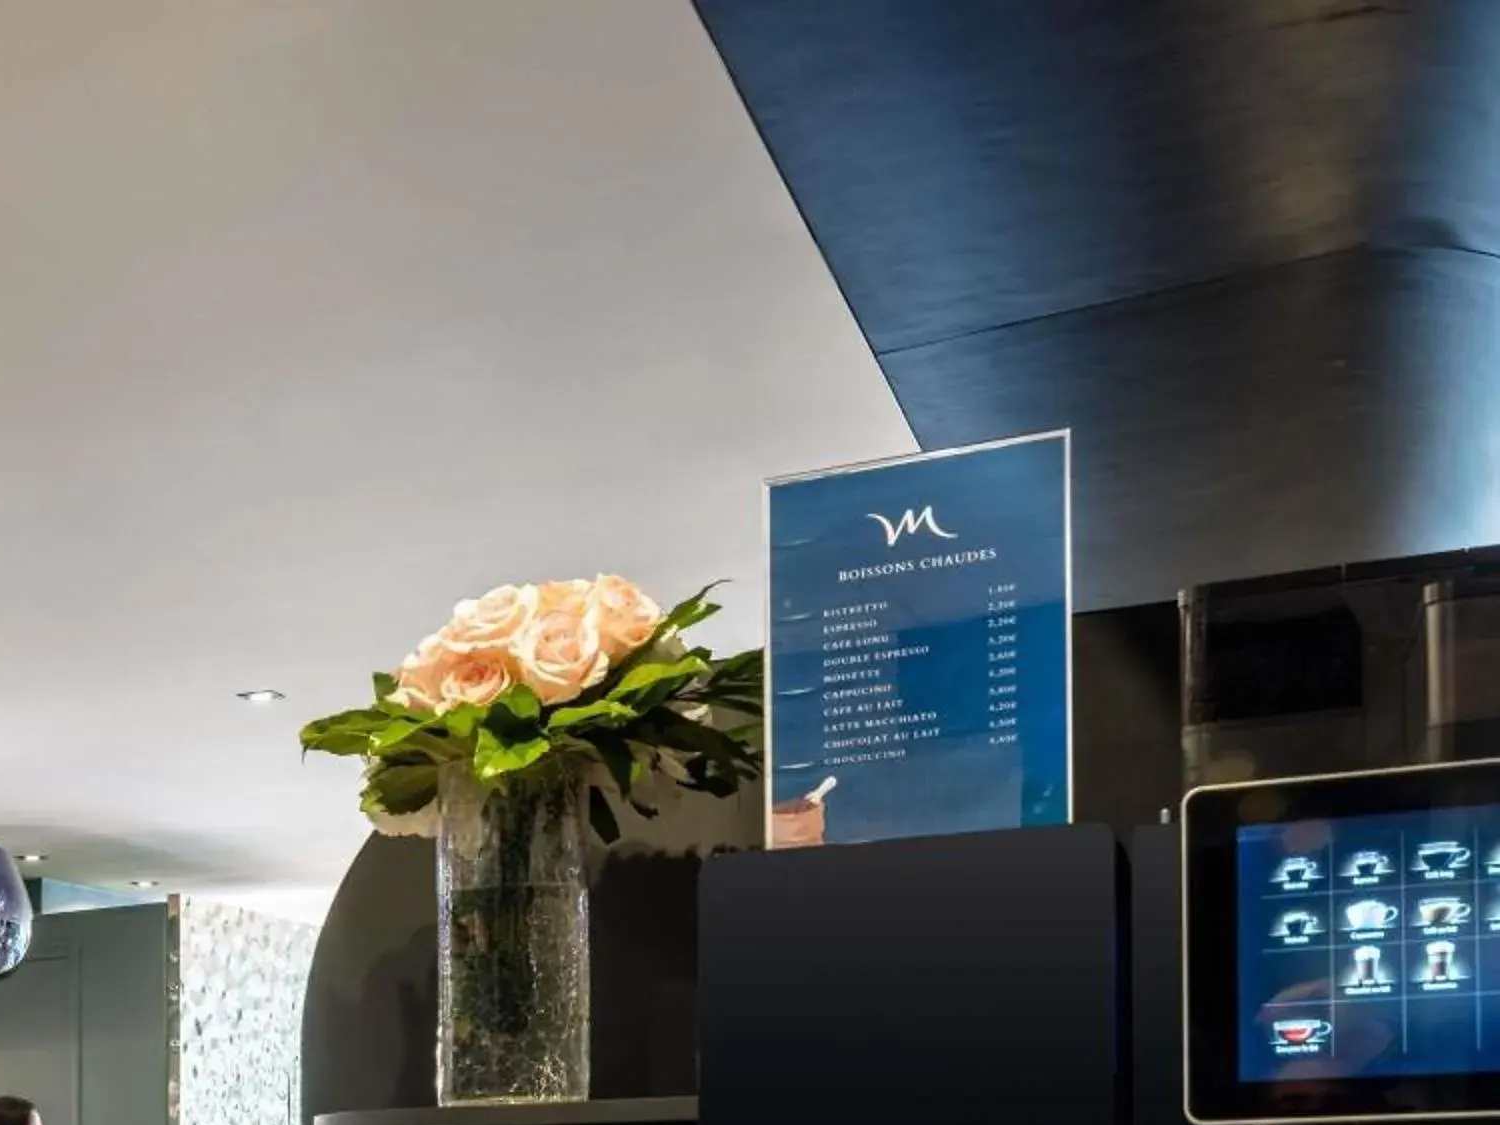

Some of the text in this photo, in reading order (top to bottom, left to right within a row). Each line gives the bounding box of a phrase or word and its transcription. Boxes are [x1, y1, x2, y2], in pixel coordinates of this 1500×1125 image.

[838, 548, 997, 582] BOISSONS CHAUDES
[823, 600, 888, 617] RISTRETTO
[823, 619, 877, 634] ESPRESSO
[823, 653, 870, 667] DOUBLE
[873, 645, 930, 660] ESPRESSO
[823, 669, 880, 683] NOISETTE
[856, 703, 874, 713] AU
[877, 699, 904, 711] LAIT
[823, 721, 860, 733] LATTE
[864, 711, 938, 728] MACCHIATO
[822, 733, 888, 749] CHOCOLAT
[893, 731, 910, 741] AU
[913, 727, 941, 740] LAIT
